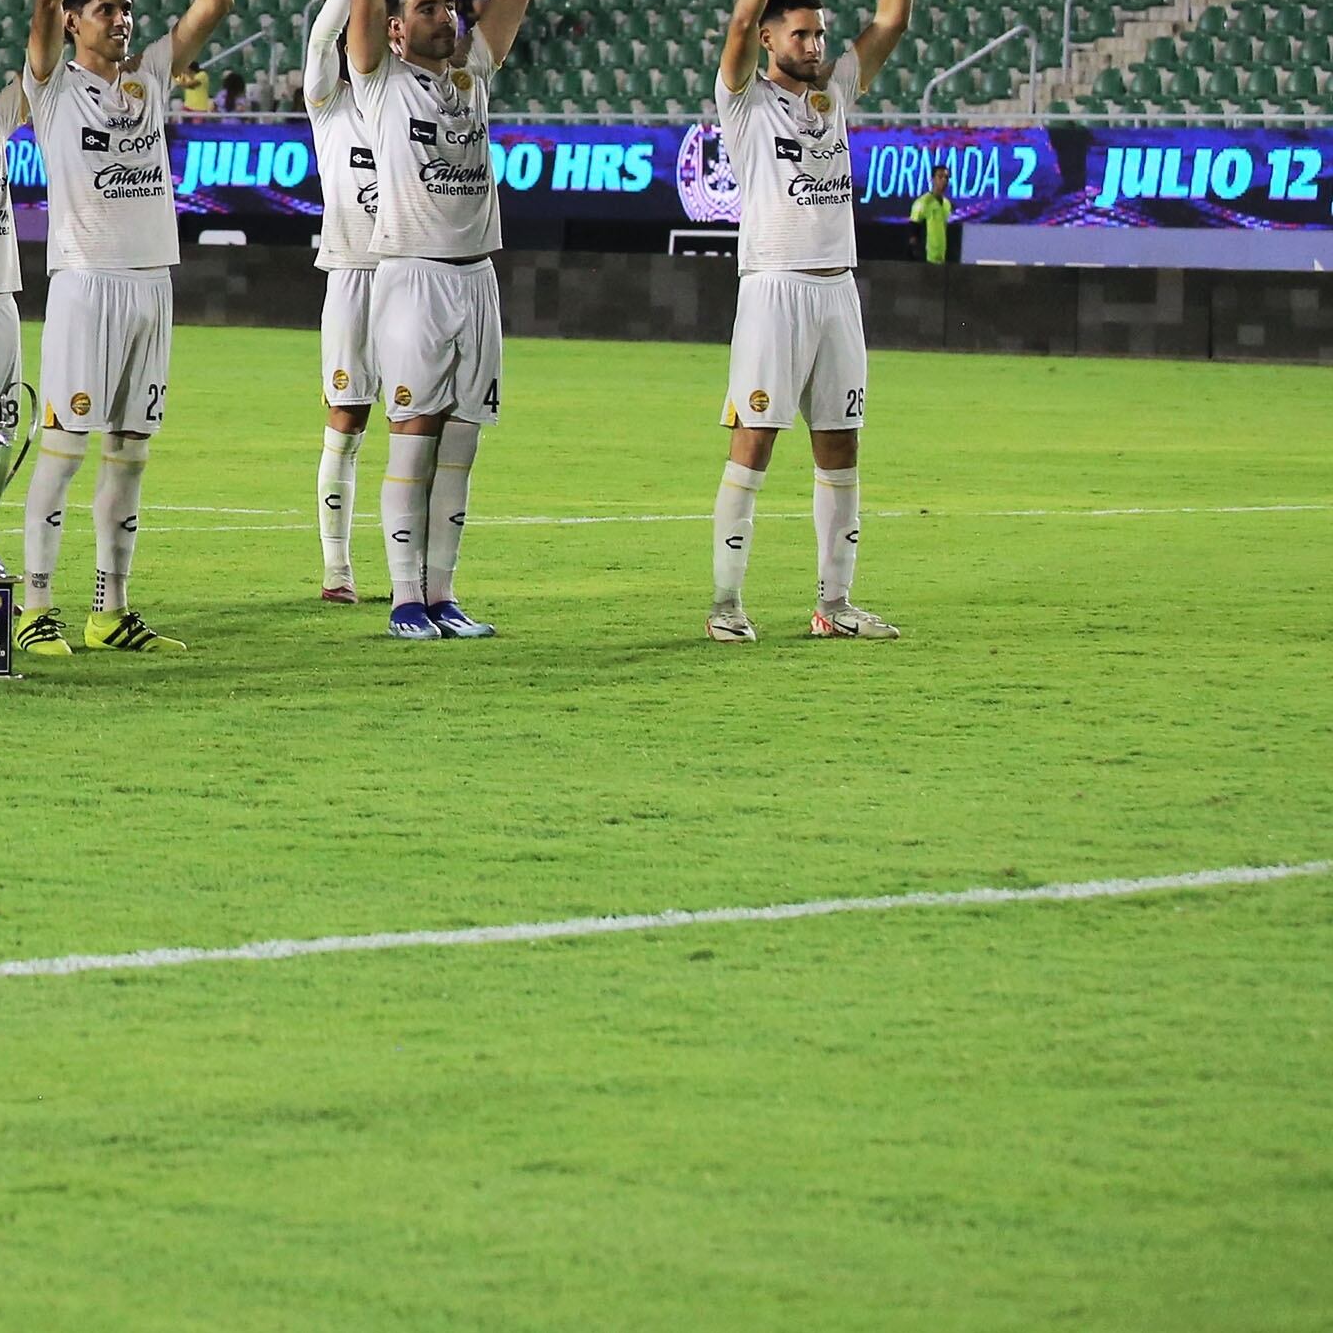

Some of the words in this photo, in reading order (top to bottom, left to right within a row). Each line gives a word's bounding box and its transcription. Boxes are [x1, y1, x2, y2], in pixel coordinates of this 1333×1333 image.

[175, 140, 309, 195] JULIO
[551, 143, 655, 193] HRS
[859, 144, 1001, 204] JORNADA
[1005, 145, 1039, 200] 2
[1093, 146, 1255, 209] JULIO
[1267, 146, 1324, 201] 12
[482, 378, 501, 414] 4
[845, 388, 864, 418] 26
